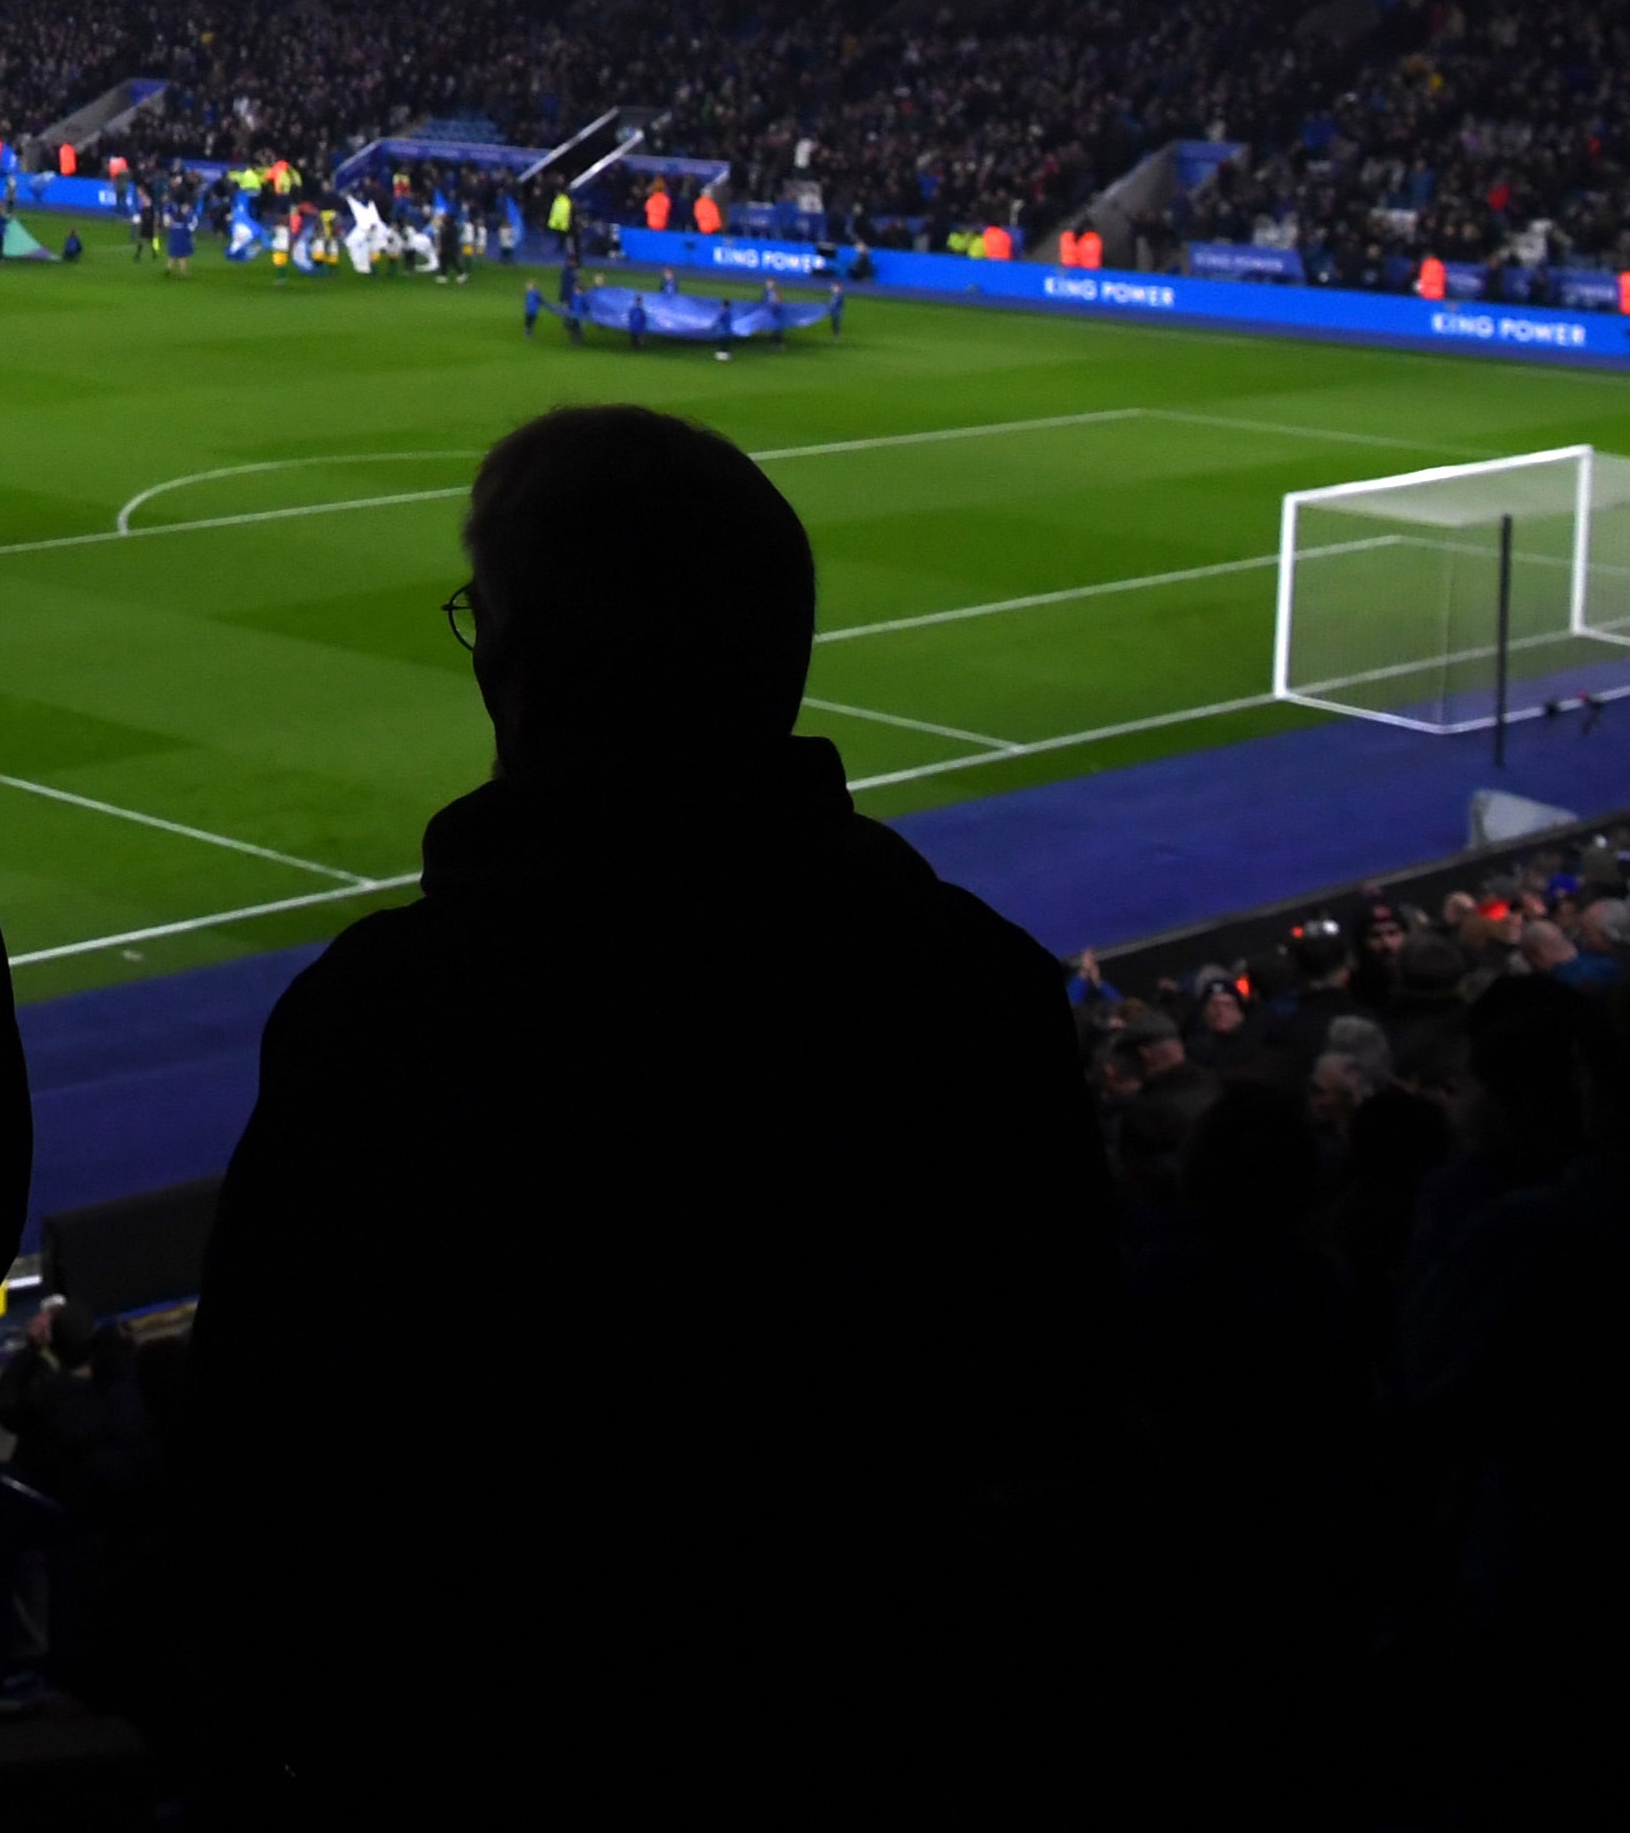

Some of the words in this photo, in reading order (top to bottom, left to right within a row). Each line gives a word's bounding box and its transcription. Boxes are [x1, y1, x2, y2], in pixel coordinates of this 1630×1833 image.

[713, 246, 758, 268] KING
[1044, 277, 1098, 301] KING
[1100, 281, 1175, 308] POWER
[1431, 312, 1495, 339] KING
[1498, 317, 1587, 348] POWER
